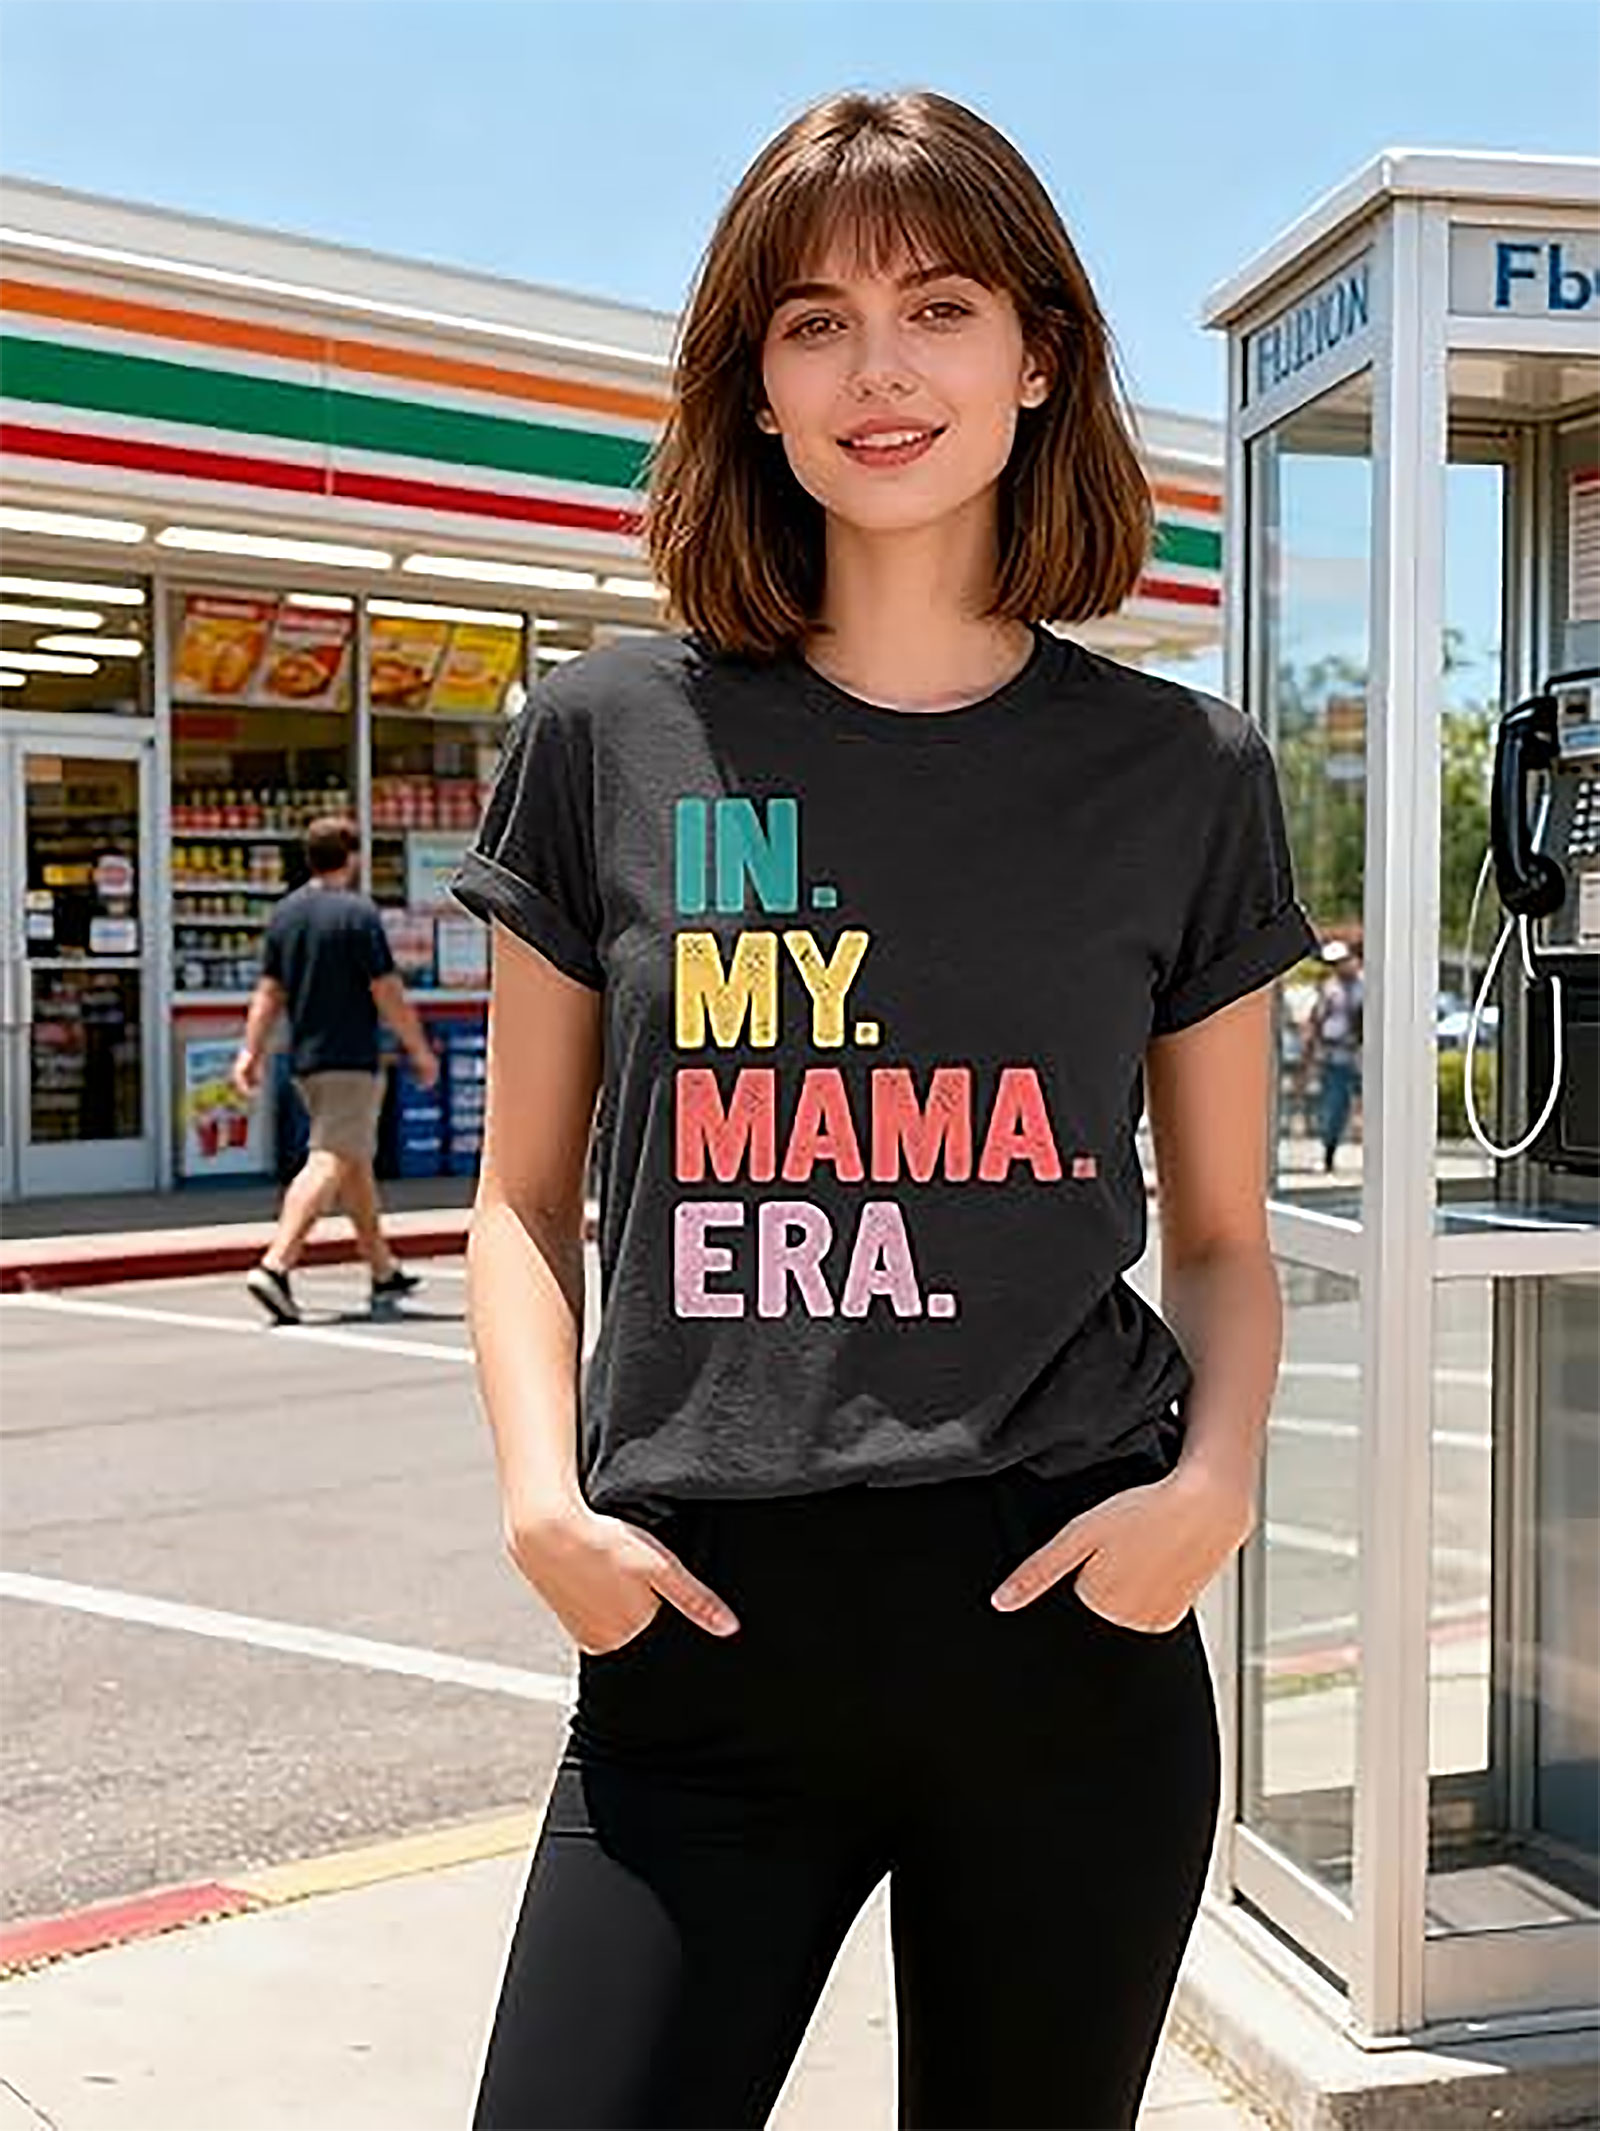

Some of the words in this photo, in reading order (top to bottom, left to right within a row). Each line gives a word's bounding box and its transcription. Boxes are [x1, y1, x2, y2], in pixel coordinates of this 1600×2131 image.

[1496, 243, 1600, 309] Fb
[675, 797, 837, 914] IN.
[675, 929, 880, 1048] MY.
[675, 1067, 1097, 1183] MAMA.
[673, 1200, 957, 1319] ERA.
